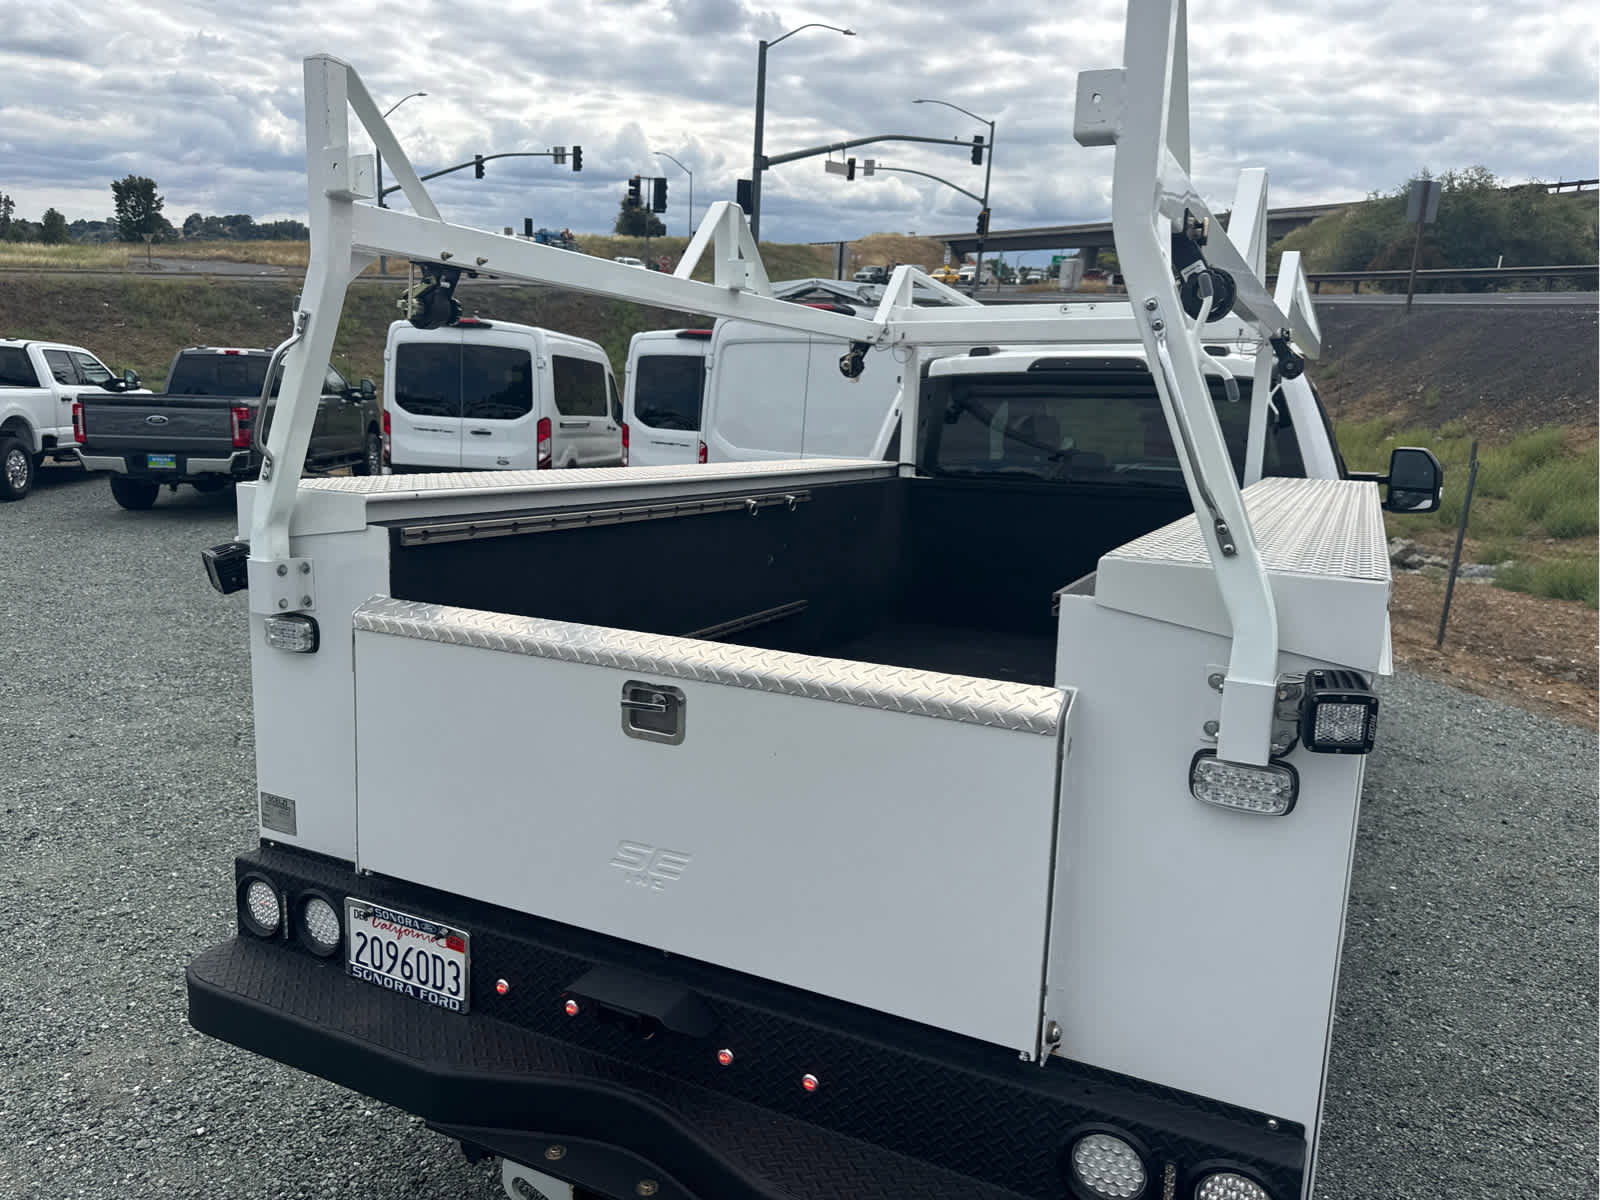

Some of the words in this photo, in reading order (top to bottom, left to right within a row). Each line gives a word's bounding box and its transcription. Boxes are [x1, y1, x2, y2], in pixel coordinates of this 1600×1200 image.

[374, 908, 421, 929] SONORA
[355, 931, 461, 996] 20960D3
[352, 965, 414, 996] SONORA
[419, 990, 460, 1011] FORD
